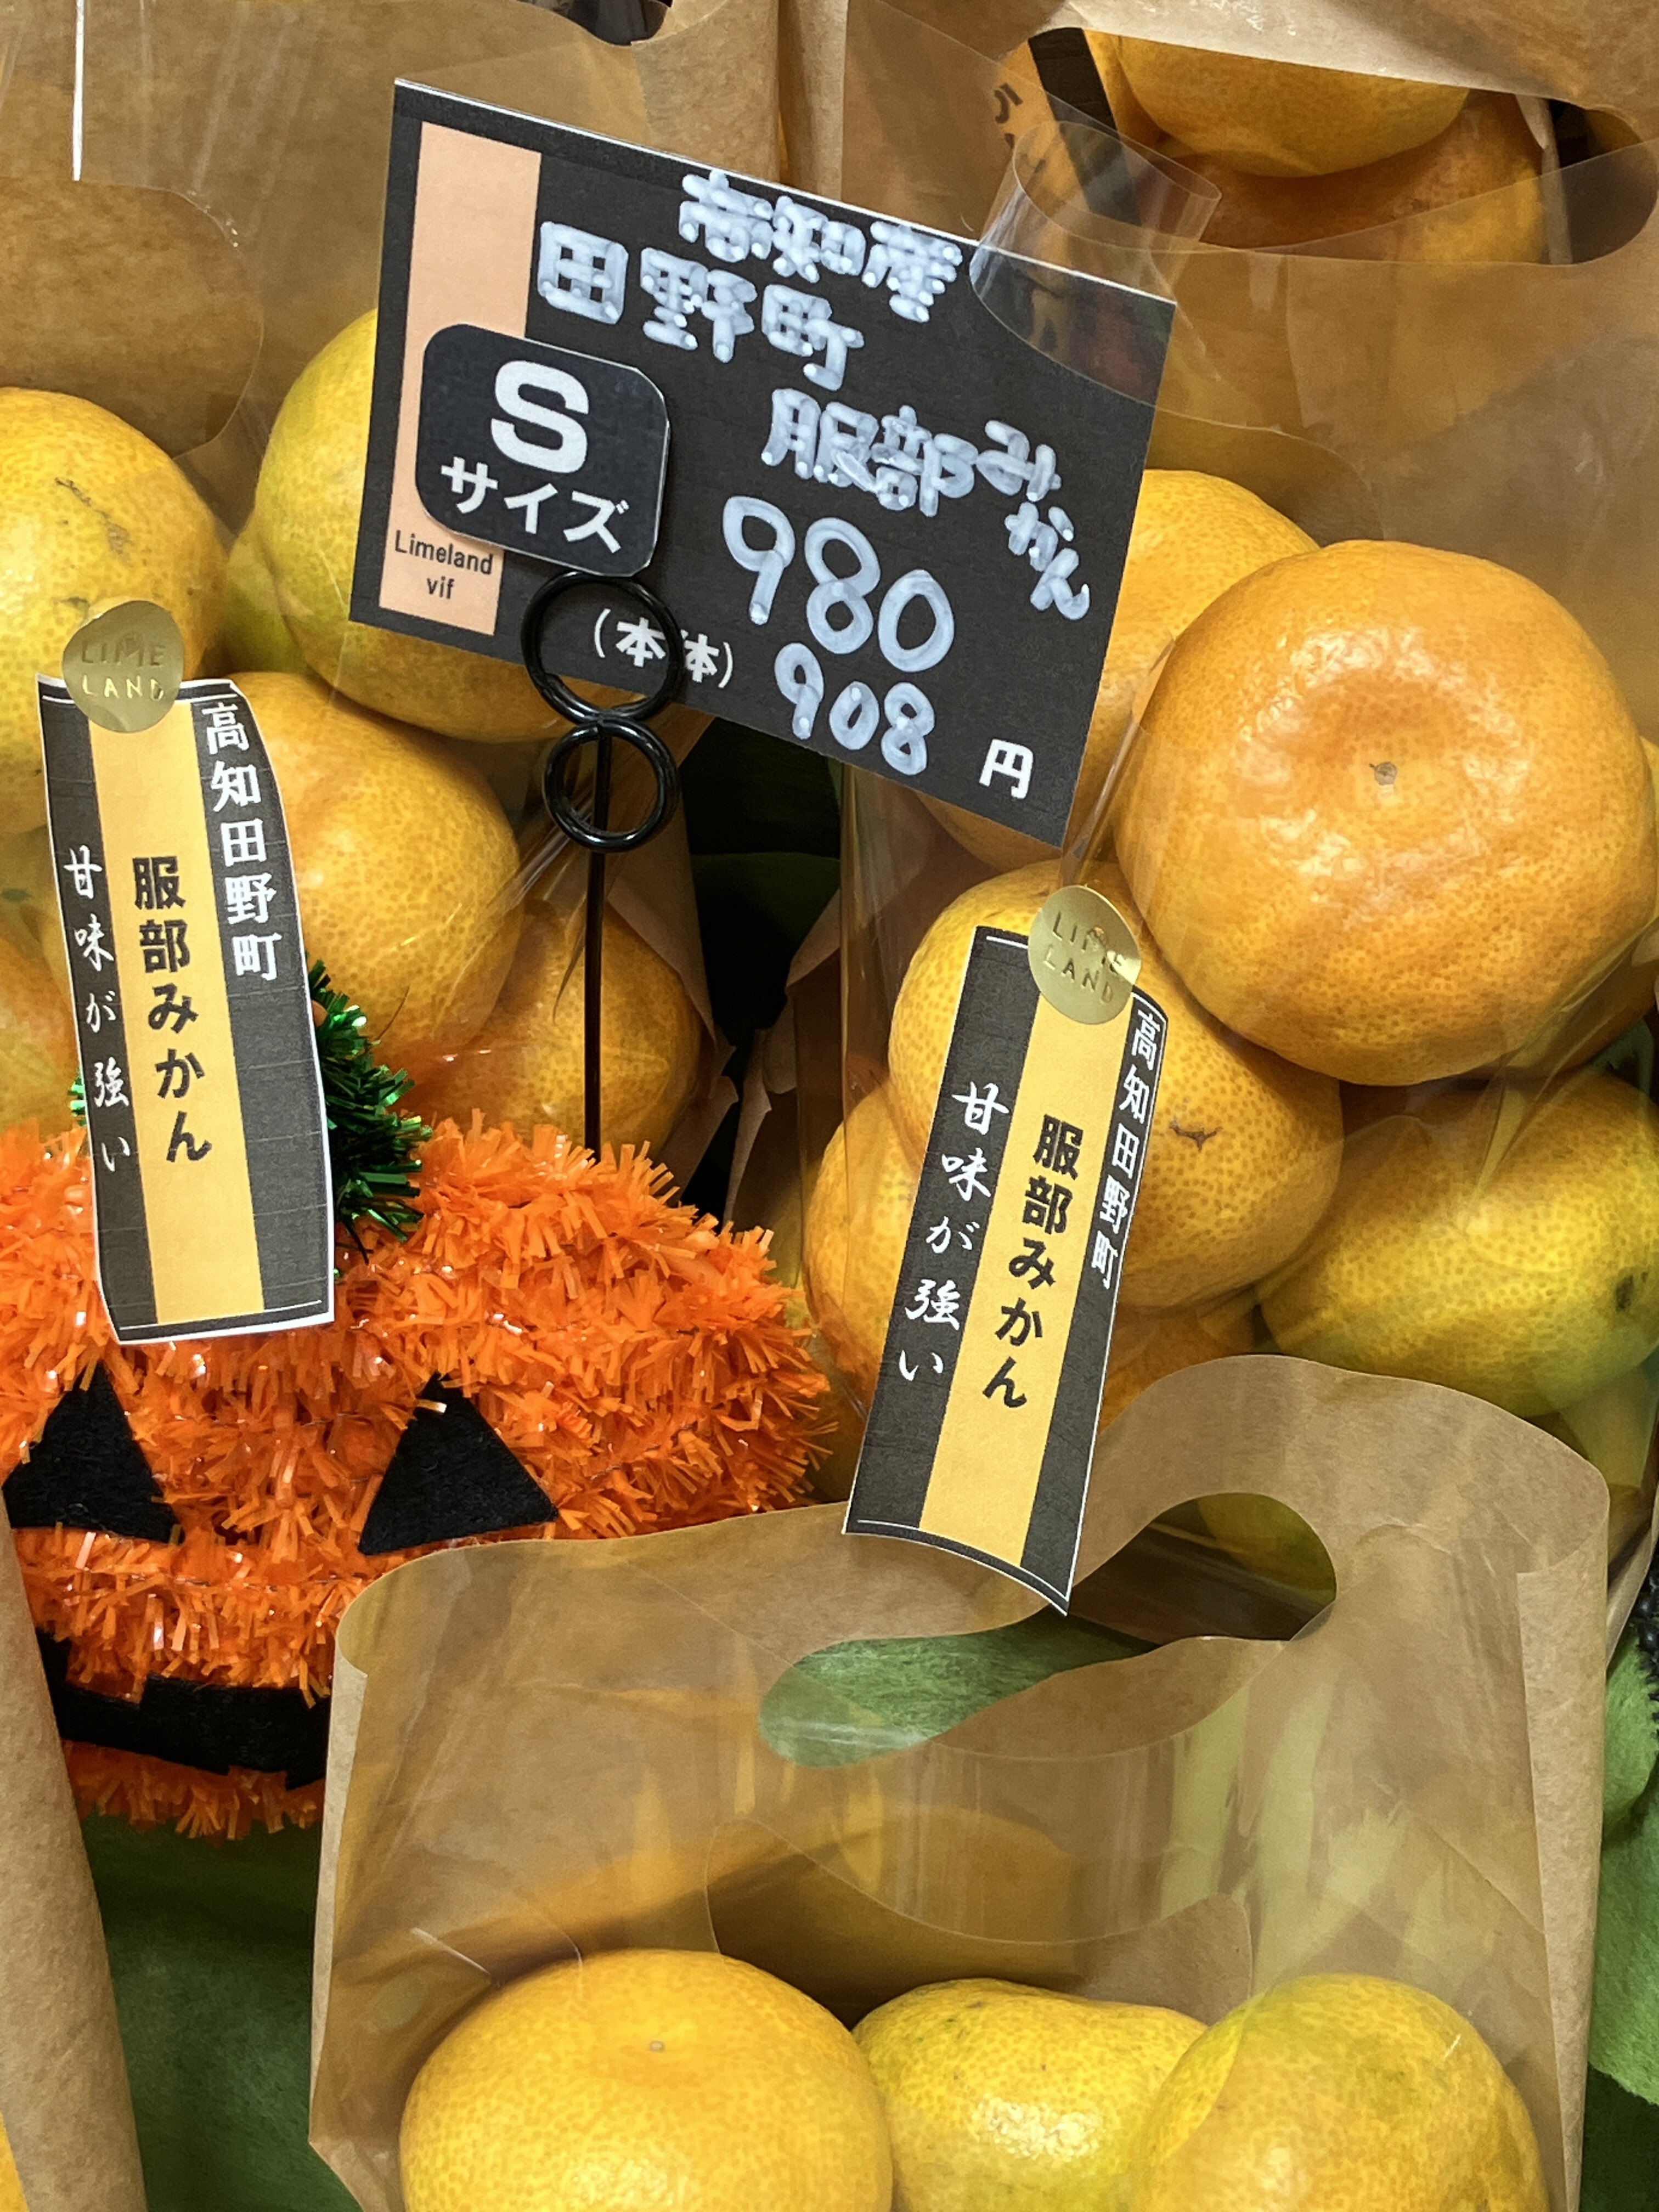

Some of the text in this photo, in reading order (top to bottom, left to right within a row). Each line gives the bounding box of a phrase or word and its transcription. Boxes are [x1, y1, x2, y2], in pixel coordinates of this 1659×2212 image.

[538, 222, 864, 390] 田野町
[679, 170, 962, 322] 高知産
[491, 360, 589, 473] S
[394, 530, 493, 575] Limeland
[441, 457, 629, 554] サイズ
[723, 495, 954, 672] 980
[761, 388, 1090, 619] 服部みかん
[82, 634, 165, 667] LIME
[427, 577, 454, 599] vif
[82, 675, 164, 702] LAND
[775, 642, 935, 775] 908
[979, 738, 1033, 799] 円
[202, 703, 281, 980] 高知田野町
[64, 847, 129, 1172] 甘味が強い
[132, 856, 212, 1163] 服部みかん
[1043, 943, 1114, 1004] LAND
[1091, 1008, 1161, 1289] 高知田野町
[899, 1081, 1009, 1381] 甘味が強い
[983, 1114, 1084, 1408] 服部みかん
